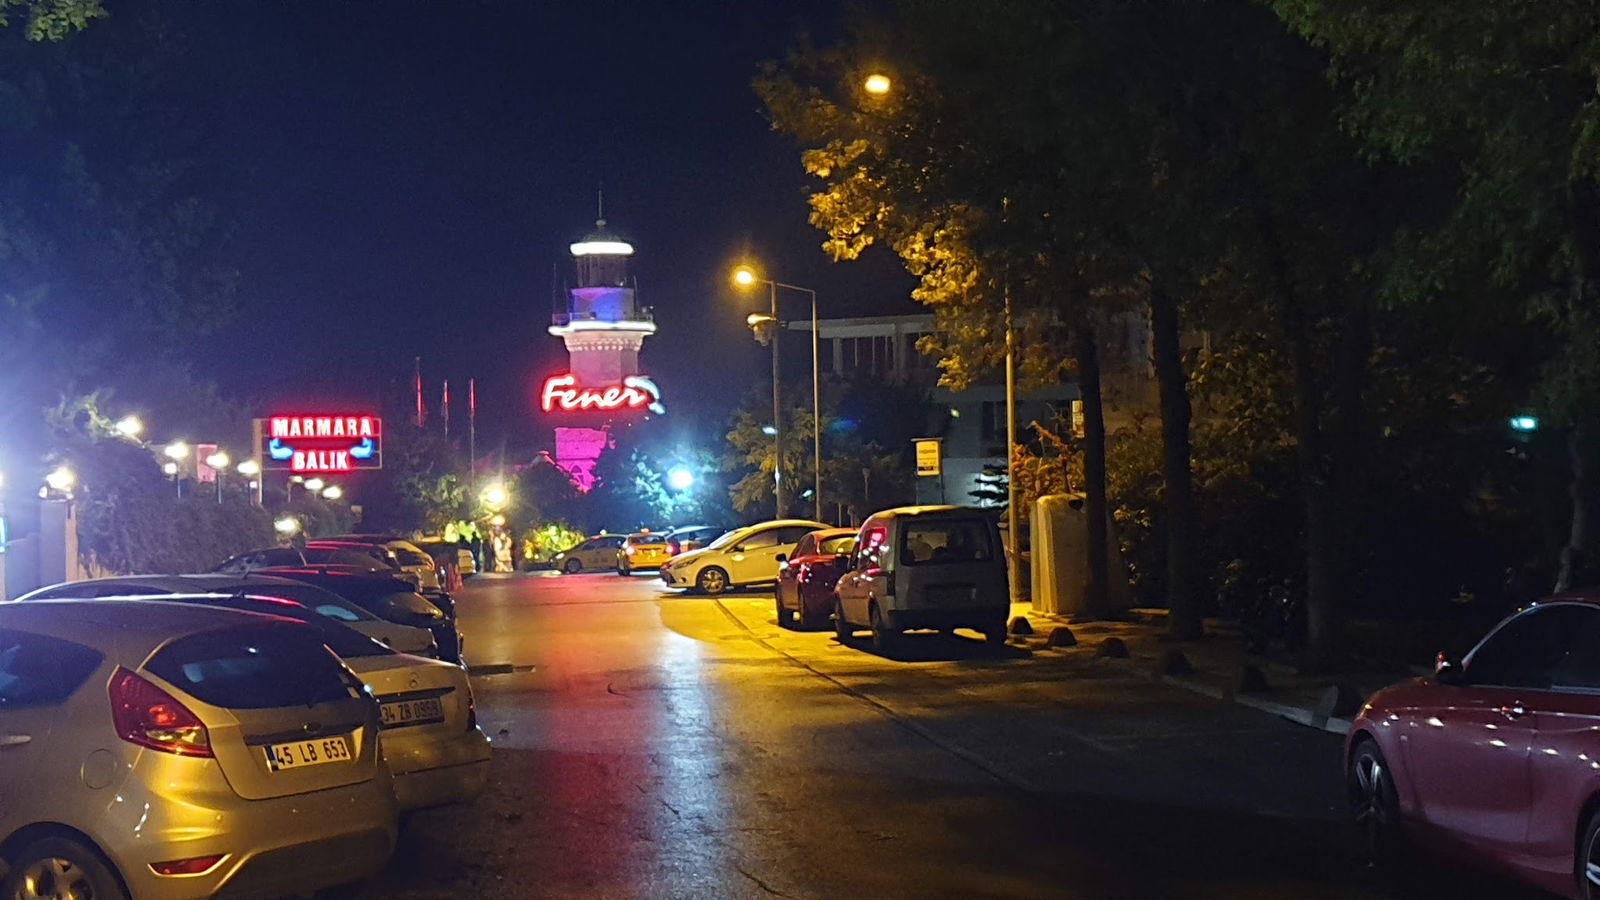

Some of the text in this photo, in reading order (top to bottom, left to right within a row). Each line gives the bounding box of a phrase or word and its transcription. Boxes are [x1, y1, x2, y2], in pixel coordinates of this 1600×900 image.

[541, 375, 648, 411] Fener
[272, 417, 372, 436] MARMARA
[292, 450, 349, 470] BALIK
[381, 706, 395, 722] 34
[275, 740, 347, 766] 45 LB 653
